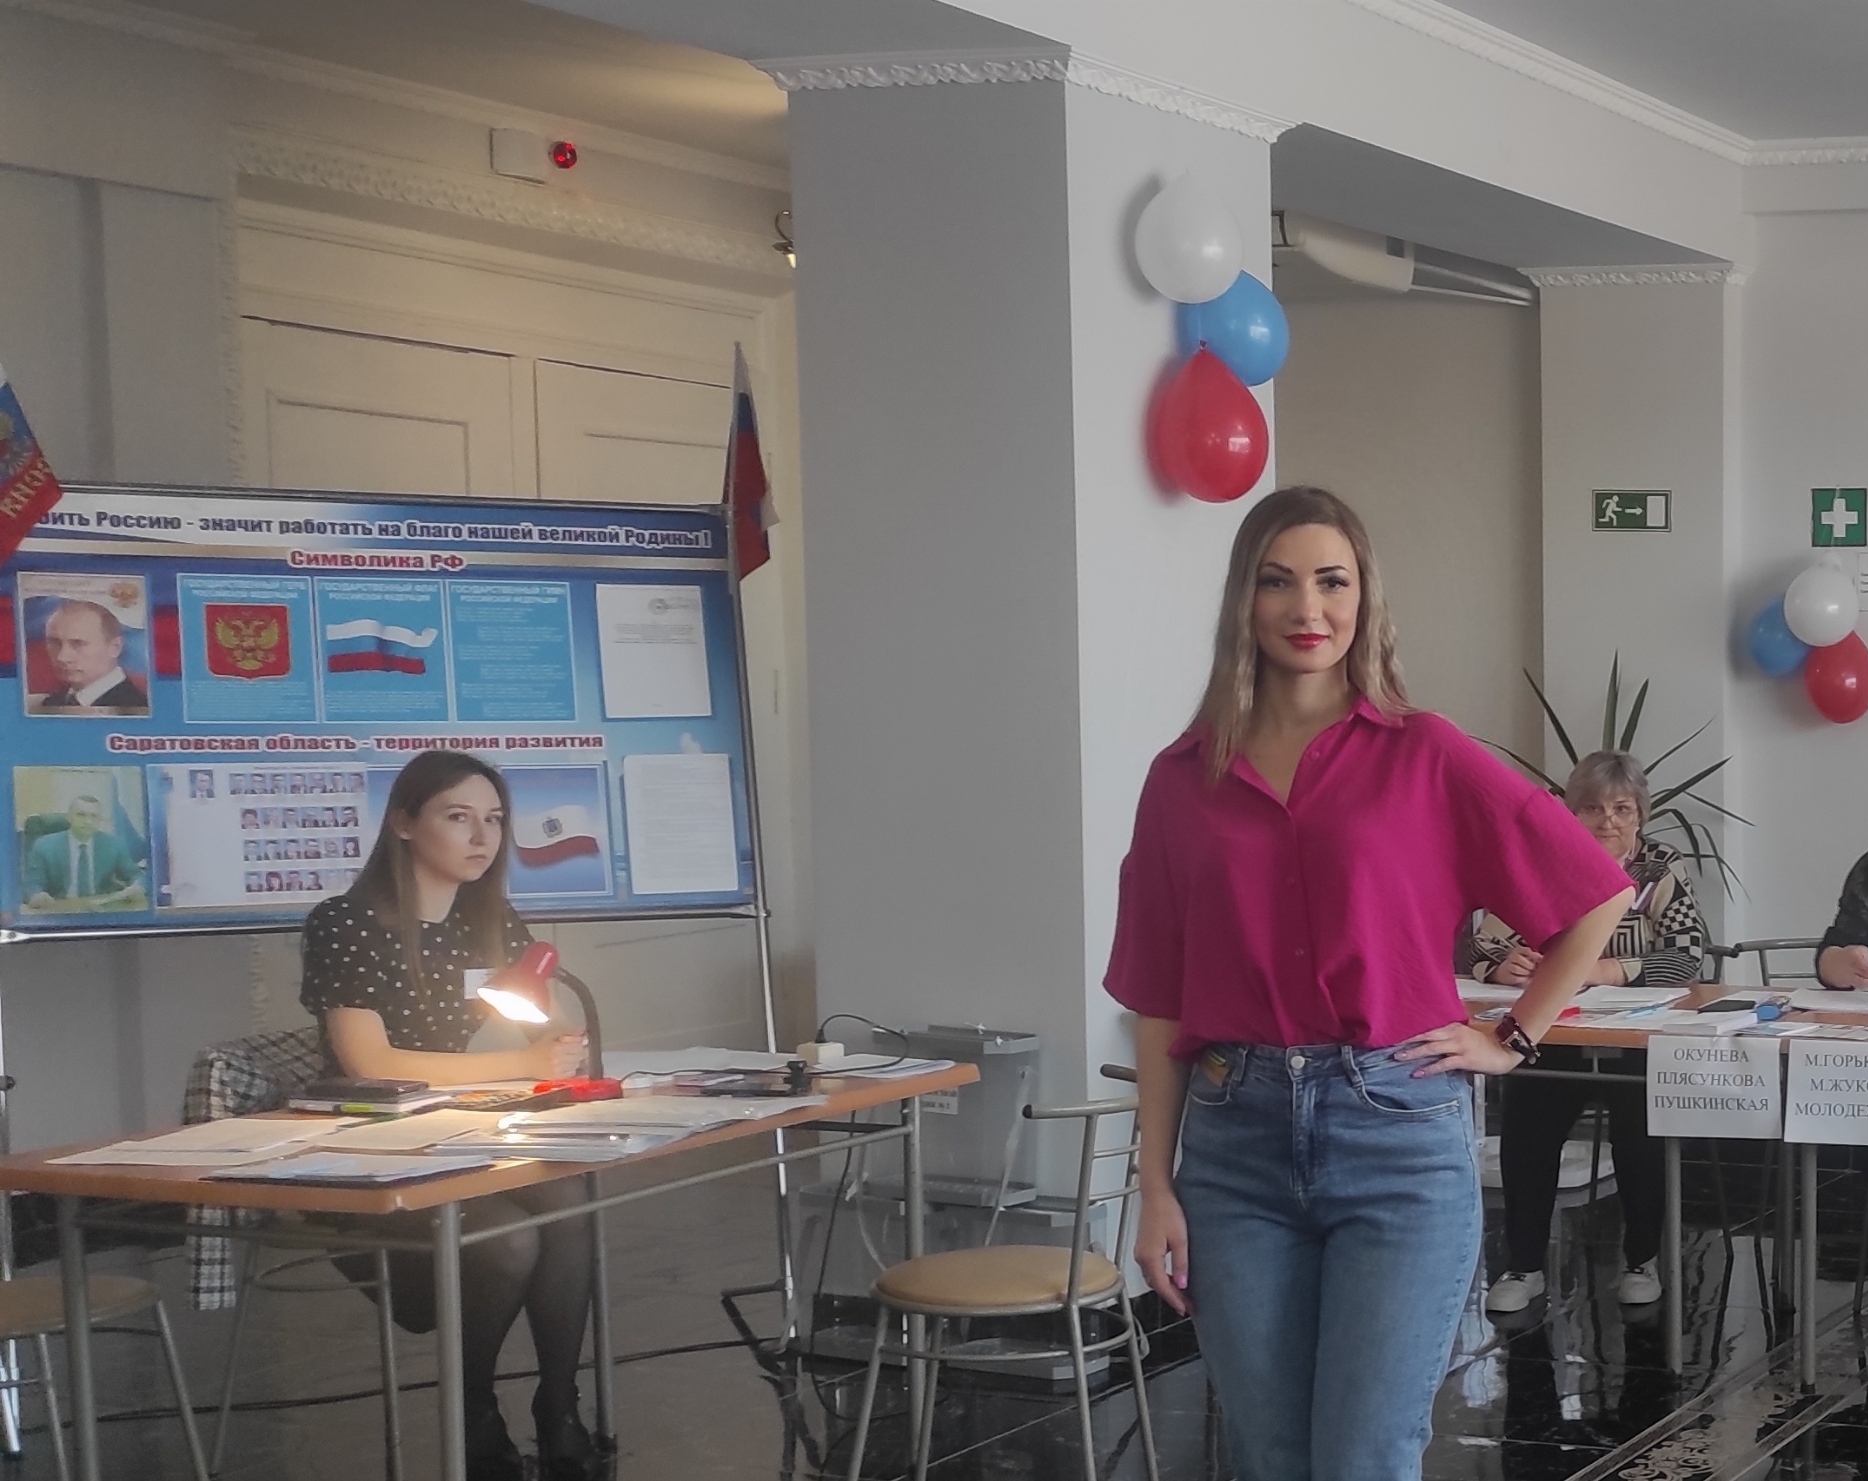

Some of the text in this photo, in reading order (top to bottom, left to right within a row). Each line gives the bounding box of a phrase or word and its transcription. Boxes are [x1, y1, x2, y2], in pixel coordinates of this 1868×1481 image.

[96, 511, 181, 530] Россию
[199, 516, 271, 534] значит
[279, 518, 372, 537] работать
[378, 523, 400, 537] на
[406, 521, 462, 539] благо
[468, 525, 533, 541] нашей
[538, 527, 619, 544] великой
[624, 530, 699, 547] Родины
[290, 550, 464, 570] Символика РФ
[110, 736, 260, 752] Саратовская
[265, 736, 357, 751] область
[375, 736, 500, 750] территория
[505, 736, 603, 750] развития
[1673, 1047, 1750, 1063] ОКУНЕВА
[1656, 1071, 1766, 1088] ПЛЯСУНКОВА
[1654, 1095, 1769, 1112] ПУШКИНСКАЯ
